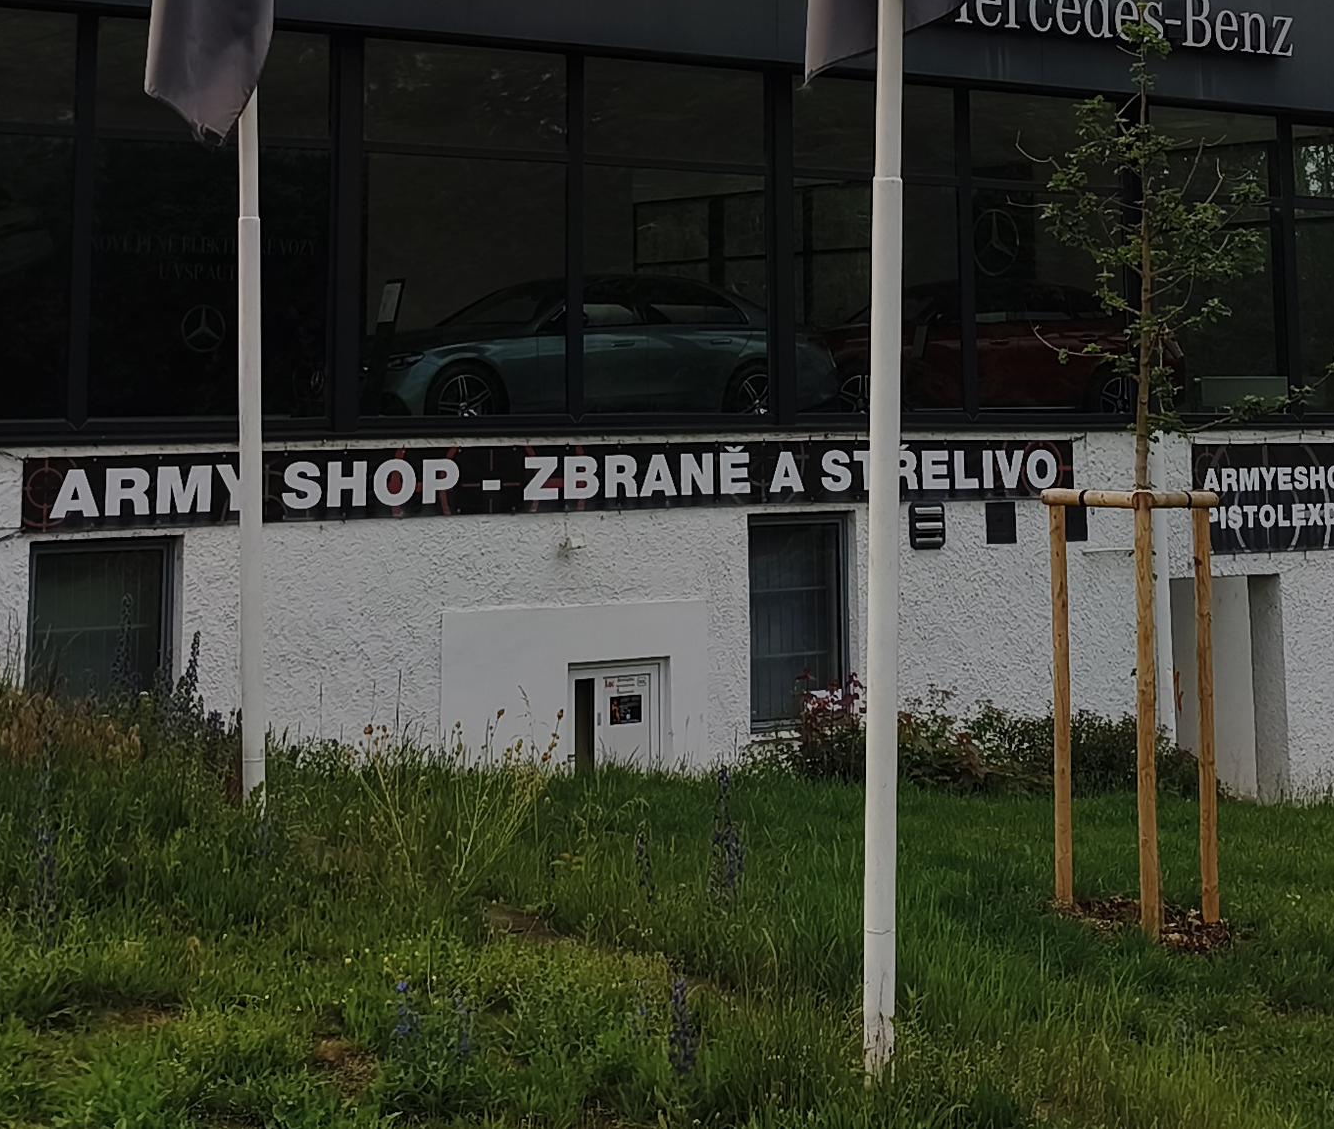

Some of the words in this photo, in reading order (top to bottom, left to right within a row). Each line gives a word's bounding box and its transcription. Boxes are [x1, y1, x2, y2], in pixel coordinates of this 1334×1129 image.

[281, 457, 460, 511] SHOP
[523, 445, 752, 501] ZBRANĚ
[769, 450, 805, 493] A
